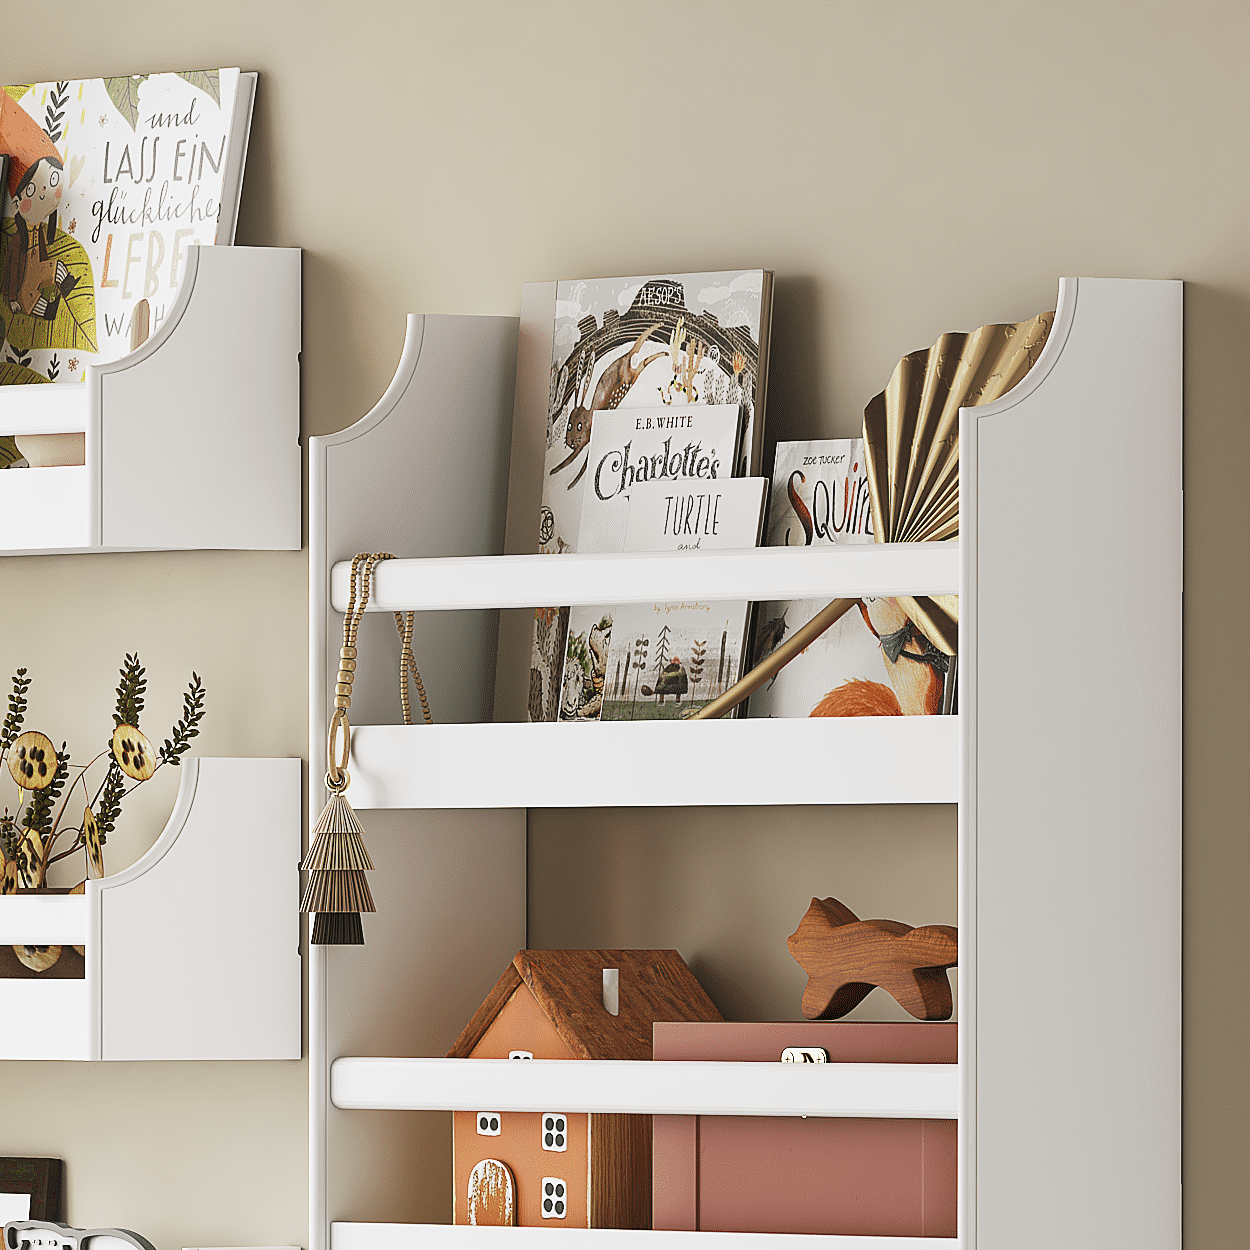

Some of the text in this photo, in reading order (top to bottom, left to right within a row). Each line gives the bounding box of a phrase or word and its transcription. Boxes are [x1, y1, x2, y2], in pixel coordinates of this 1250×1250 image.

[144, 97, 201, 129] und
[103, 136, 160, 184] LASS
[100, 228, 202, 300] LEBE
[638, 286, 684, 306] AESOP'S
[594, 435, 720, 501] Charlotte's
[663, 494, 722, 536] TURTLE
[677, 537, 701, 551] and
